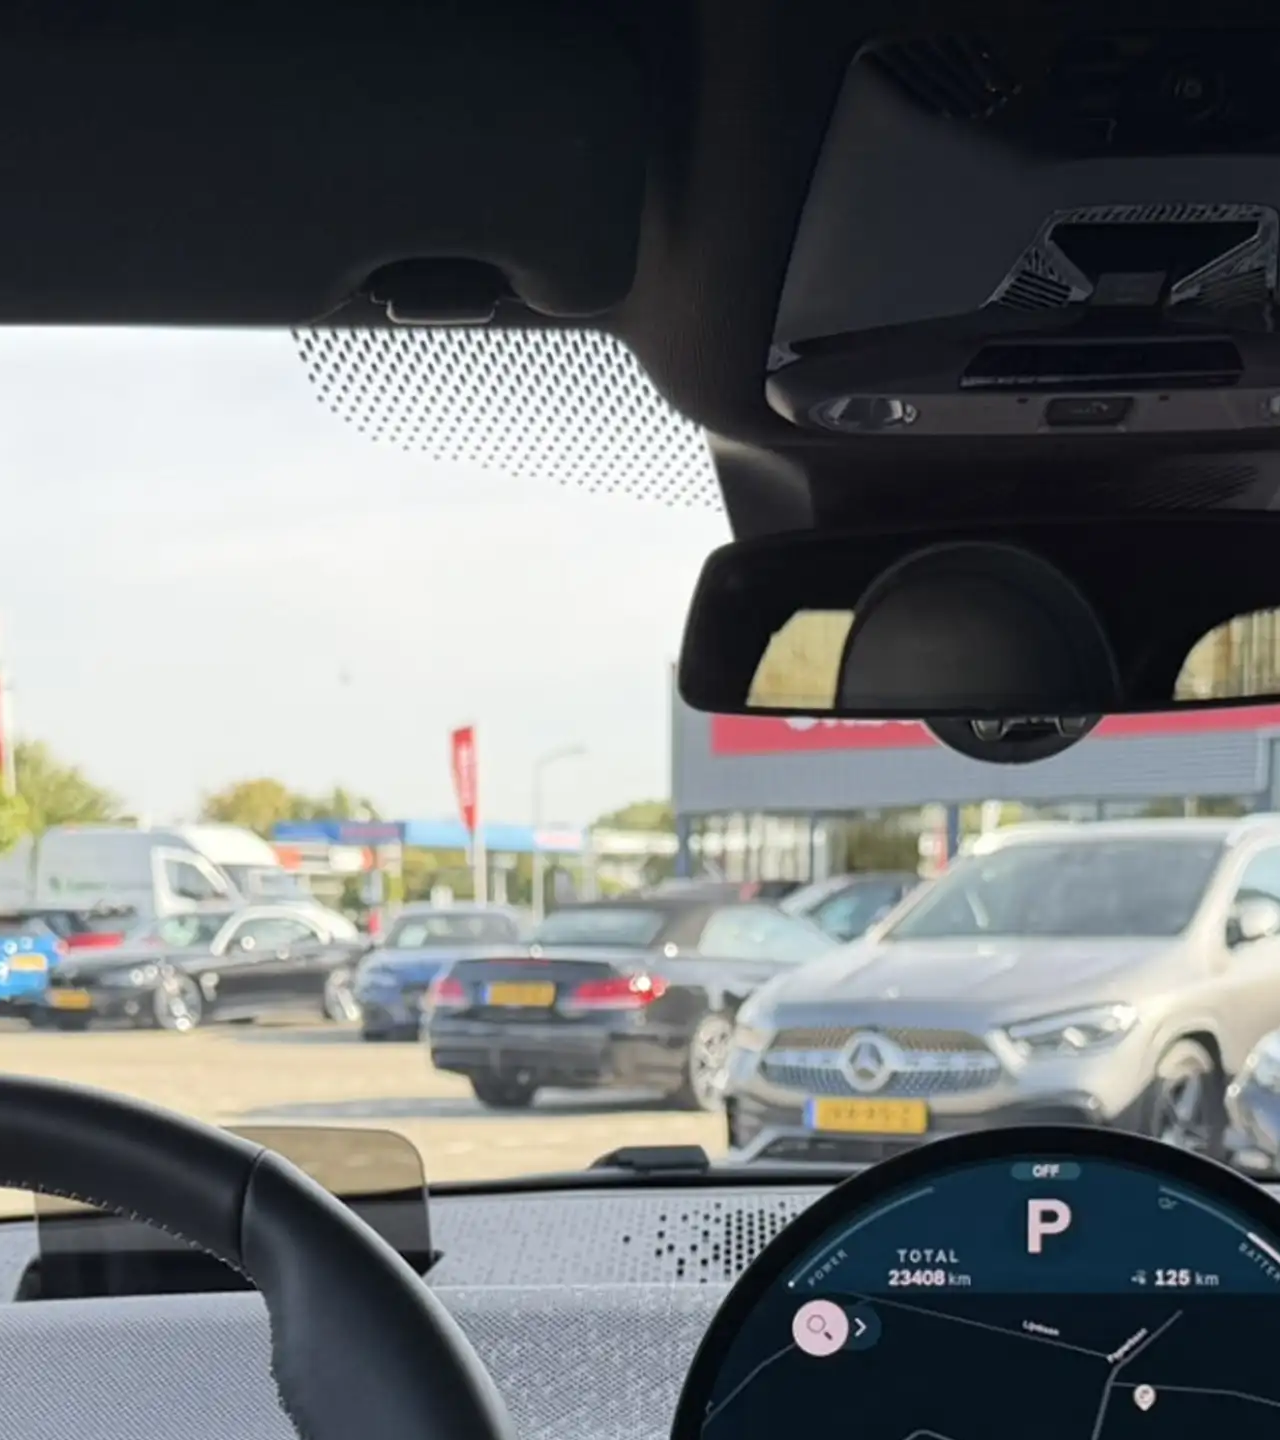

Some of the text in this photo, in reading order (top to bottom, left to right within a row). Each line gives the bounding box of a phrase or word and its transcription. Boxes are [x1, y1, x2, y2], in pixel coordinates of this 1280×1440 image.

[1031, 1163, 1061, 1179] OFF
[1027, 1198, 1072, 1254] P
[896, 1248, 960, 1264] TOTAL
[887, 1268, 972, 1287] 23408 km
[1154, 1268, 1220, 1287] 125 km
